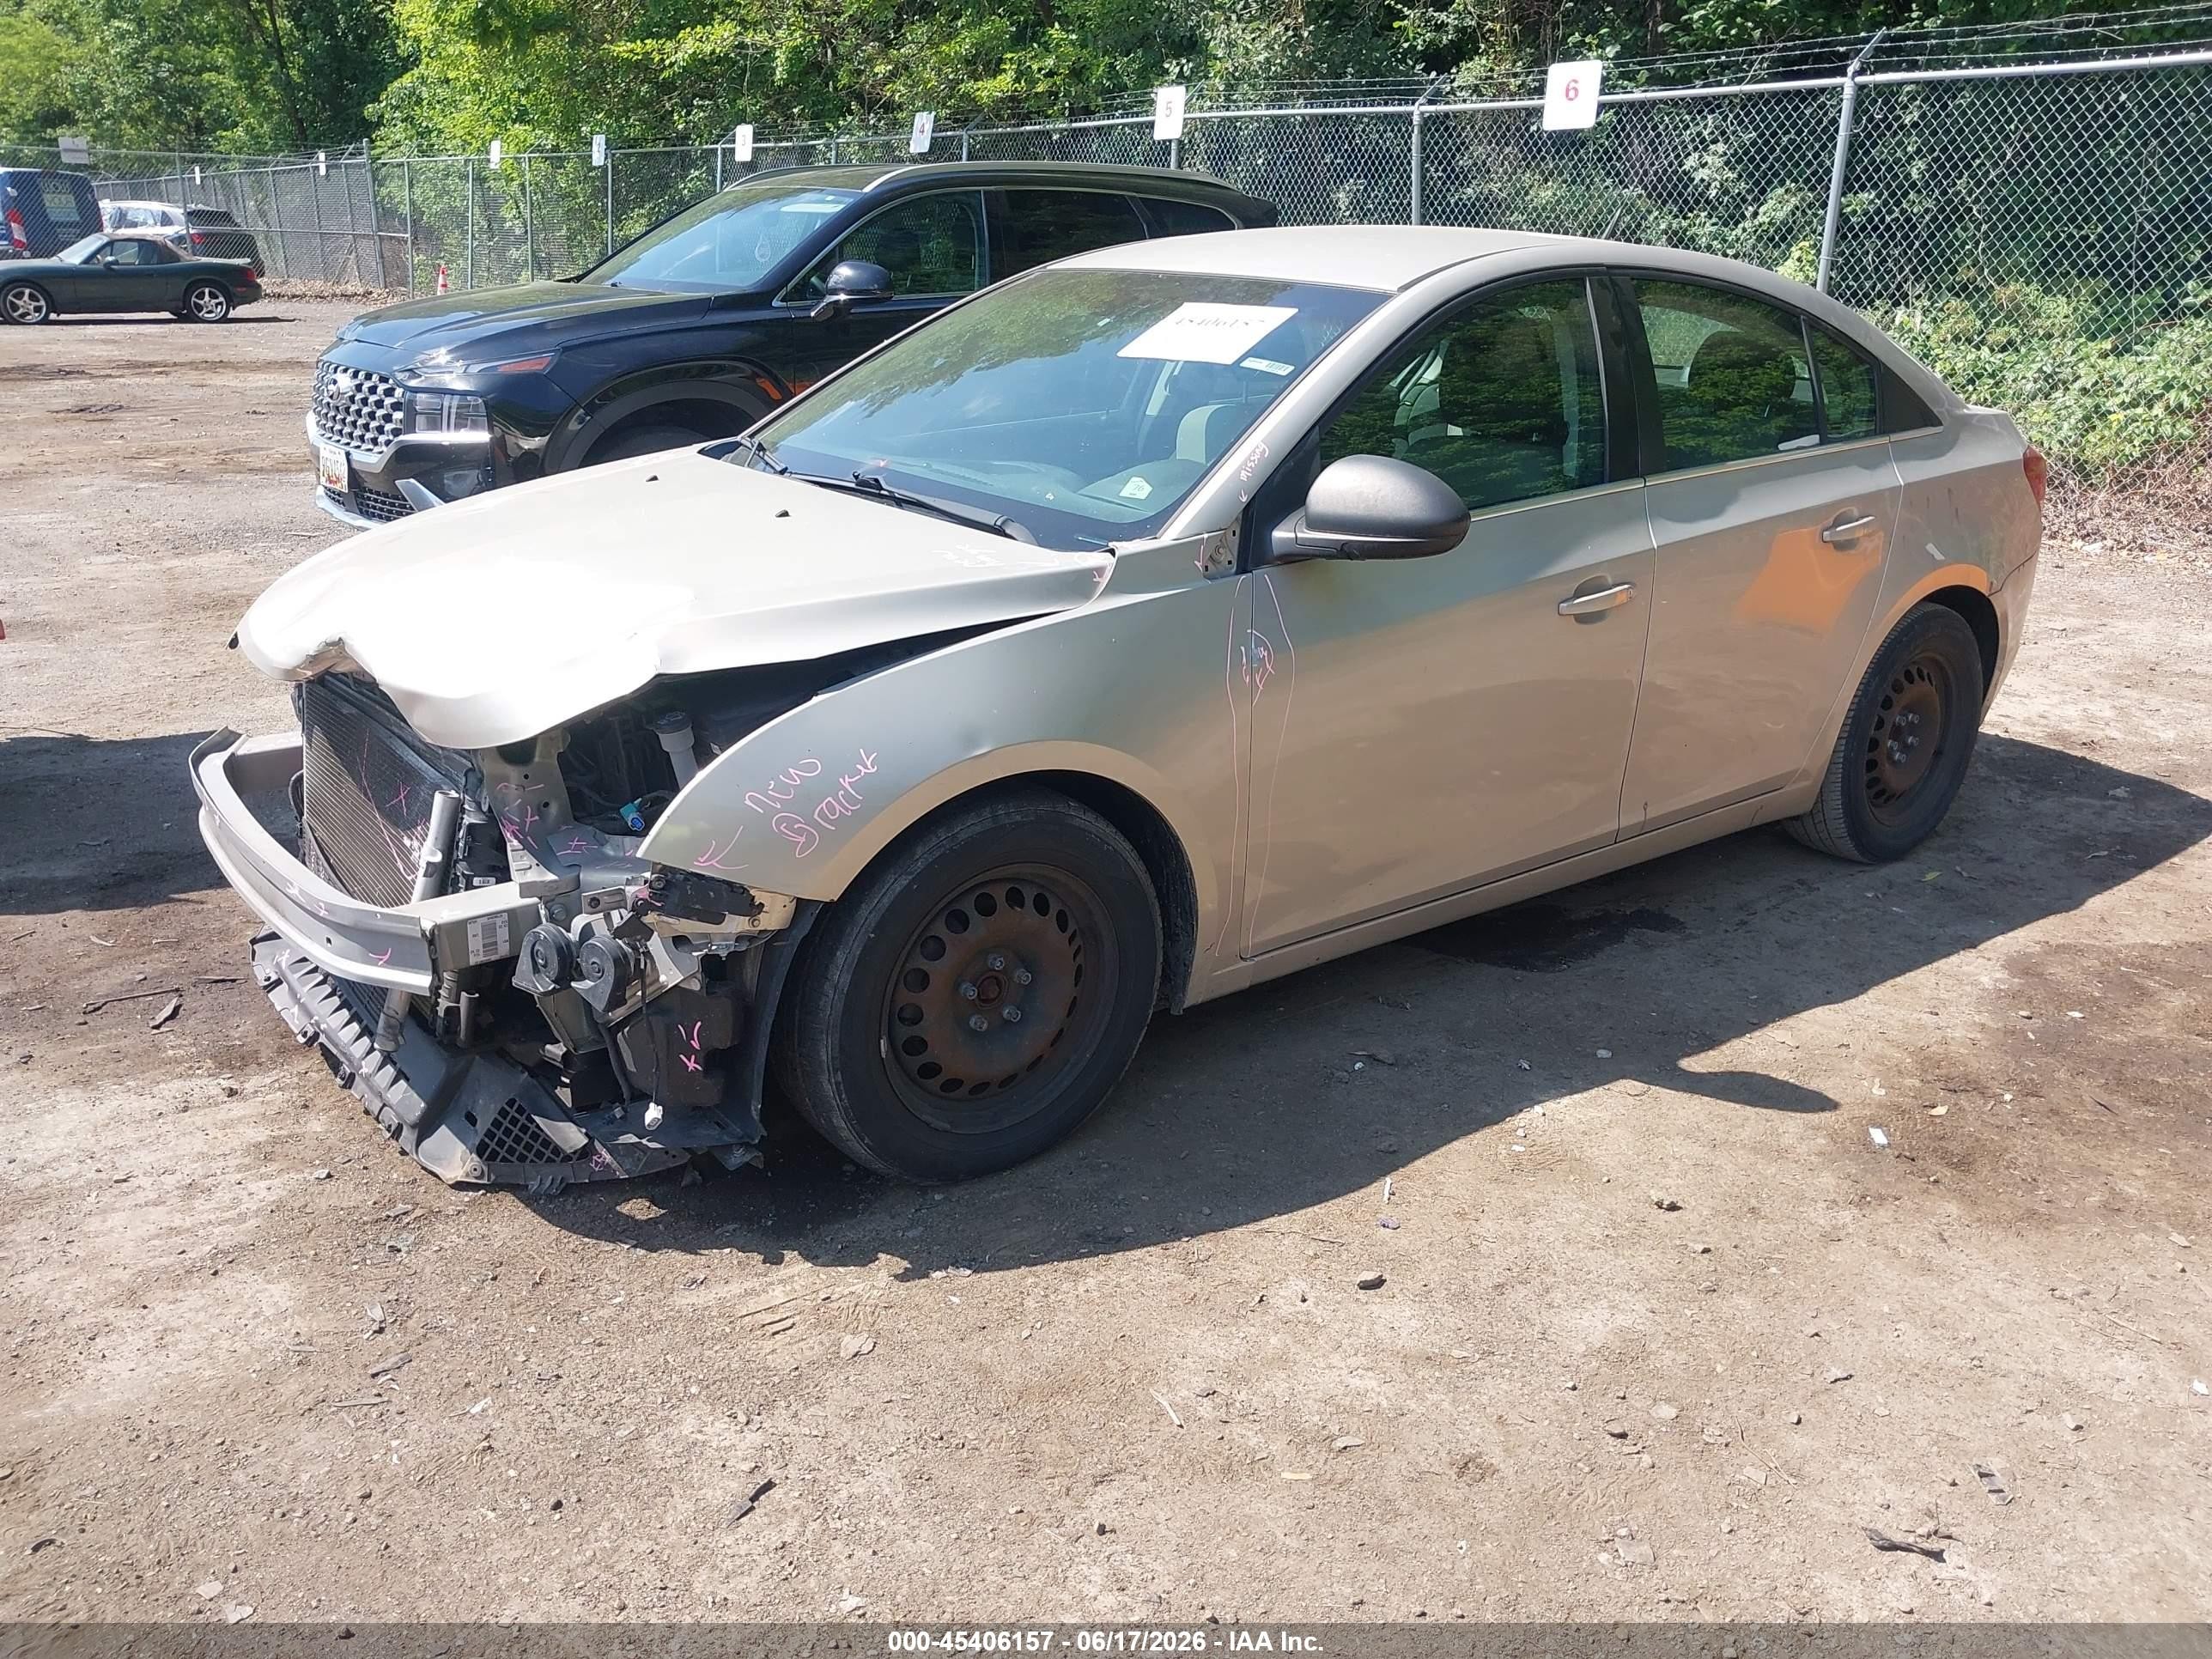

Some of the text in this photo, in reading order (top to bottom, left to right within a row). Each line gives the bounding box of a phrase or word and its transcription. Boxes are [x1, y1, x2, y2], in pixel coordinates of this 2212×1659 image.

[1565, 79, 1579, 101] 6
[1164, 100, 1173, 118] 5
[919, 122, 925, 136] 4
